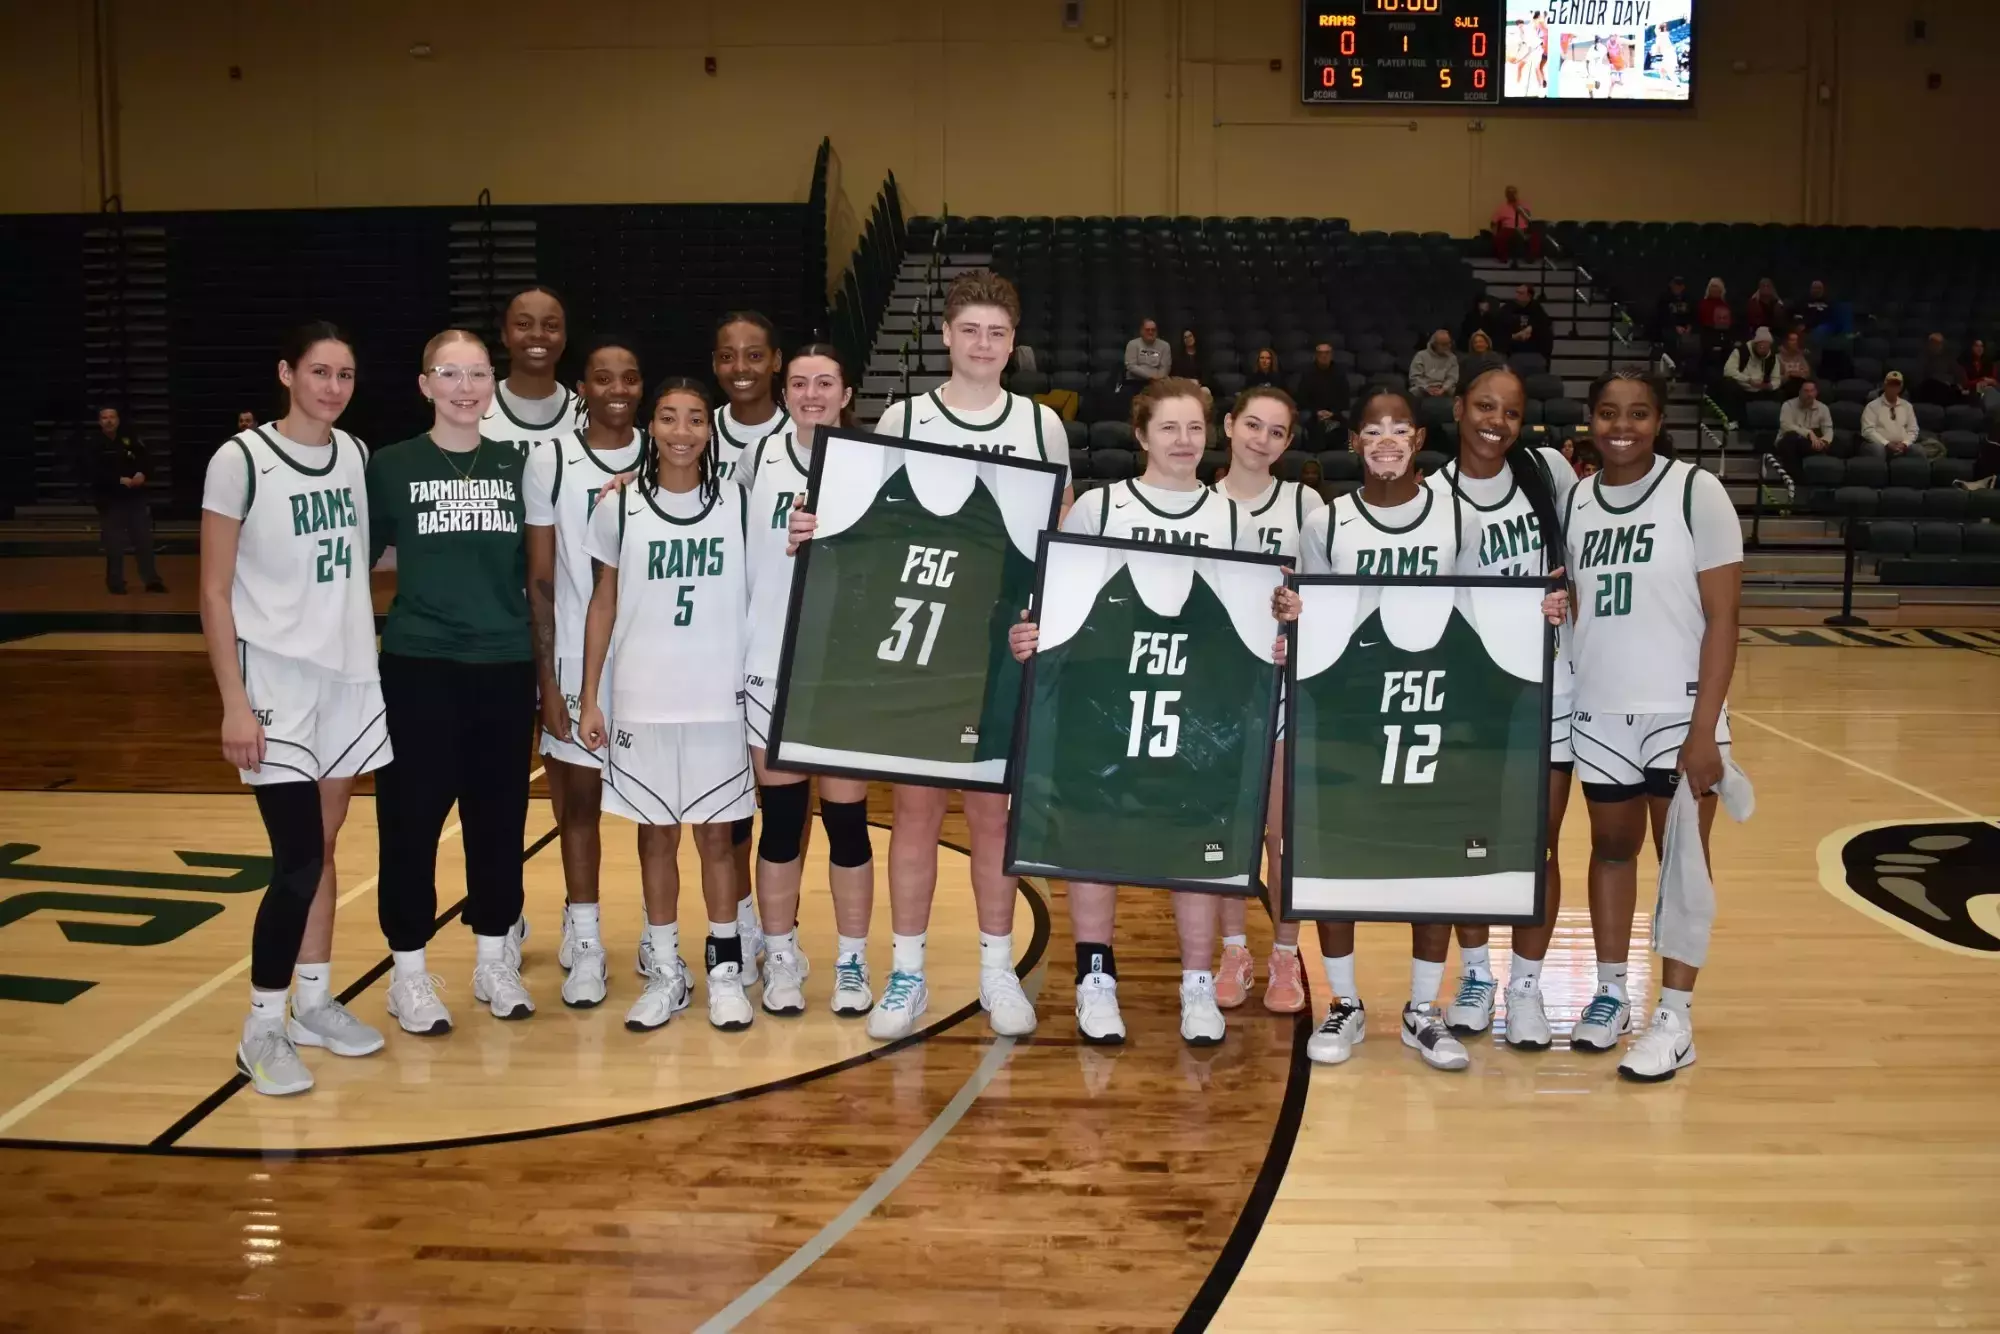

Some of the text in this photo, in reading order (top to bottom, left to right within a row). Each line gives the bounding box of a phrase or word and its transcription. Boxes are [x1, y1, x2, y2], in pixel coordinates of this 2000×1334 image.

[1319, 15, 1356, 27] RAMS
[1454, 16, 1479, 28] SJLI
[1547, 0, 1650, 26] SENIOR DAY!
[1341, 31, 1355, 55] 0
[1403, 35, 1408, 52] 1
[1472, 33, 1486, 57] 0
[1323, 67, 1335, 87] 0
[1351, 67, 1363, 87] 5
[1439, 69, 1451, 88] 5
[1474, 69, 1485, 88] 0
[409, 479, 516, 503] FARMINGDALE
[289, 487, 357, 536] RAMS
[418, 509, 518, 535] BASKETBALL
[317, 536, 352, 583] 24
[648, 537, 724, 580] RAMS
[1356, 545, 1438, 576] RAMS
[1579, 523, 1656, 570] RAMS
[900, 544, 959, 588] FSC
[673, 585, 695, 626] 5
[1595, 572, 1632, 617] 20
[877, 596, 946, 666] 31
[1128, 631, 1188, 675] FSC
[1380, 670, 1446, 713] FSC
[1127, 690, 1181, 757] 15
[1381, 724, 1441, 784] 12
